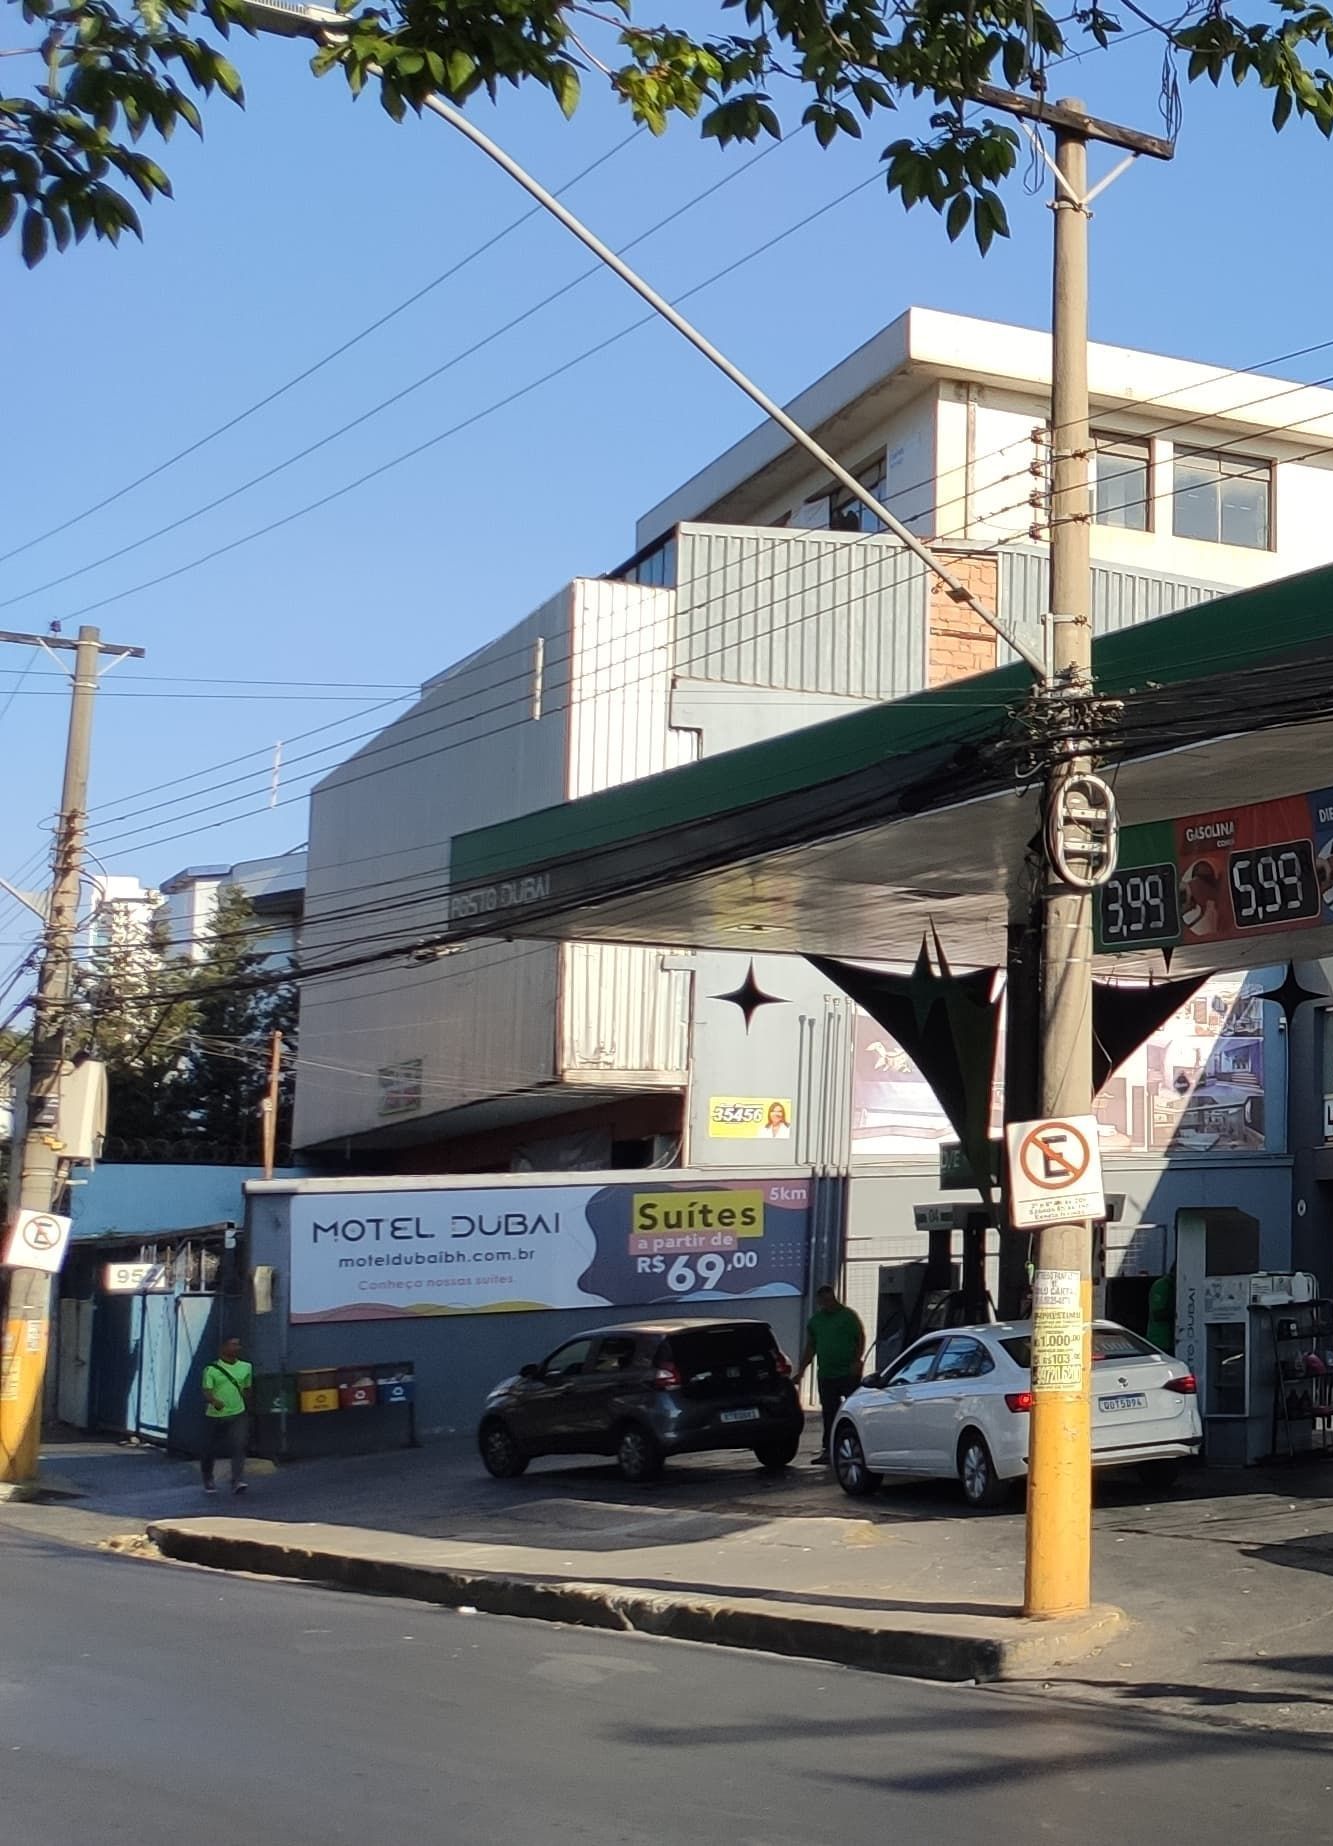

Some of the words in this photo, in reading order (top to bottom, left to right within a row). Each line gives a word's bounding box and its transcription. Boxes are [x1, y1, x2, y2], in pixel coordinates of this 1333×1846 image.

[1185, 821, 1236, 843] GASOLINA
[1232, 851, 1301, 920] 5,99
[1107, 875, 1165, 937] 3,99
[711, 1106, 763, 1123] 35456
[769, 1187, 807, 1200] 5km
[638, 1202, 756, 1231] Suítes
[313, 1217, 435, 1243] MOTEL
[451, 1212, 560, 1239] DUBAI
[638, 1239, 648, 1249] a
[653, 1235, 705, 1251] partir
[711, 1234, 733, 1246] de
[338, 1248, 535, 1268] moteldubaibh.com.br
[358, 1275, 423, 1291] Conheça
[427, 1276, 472, 1288] nossas
